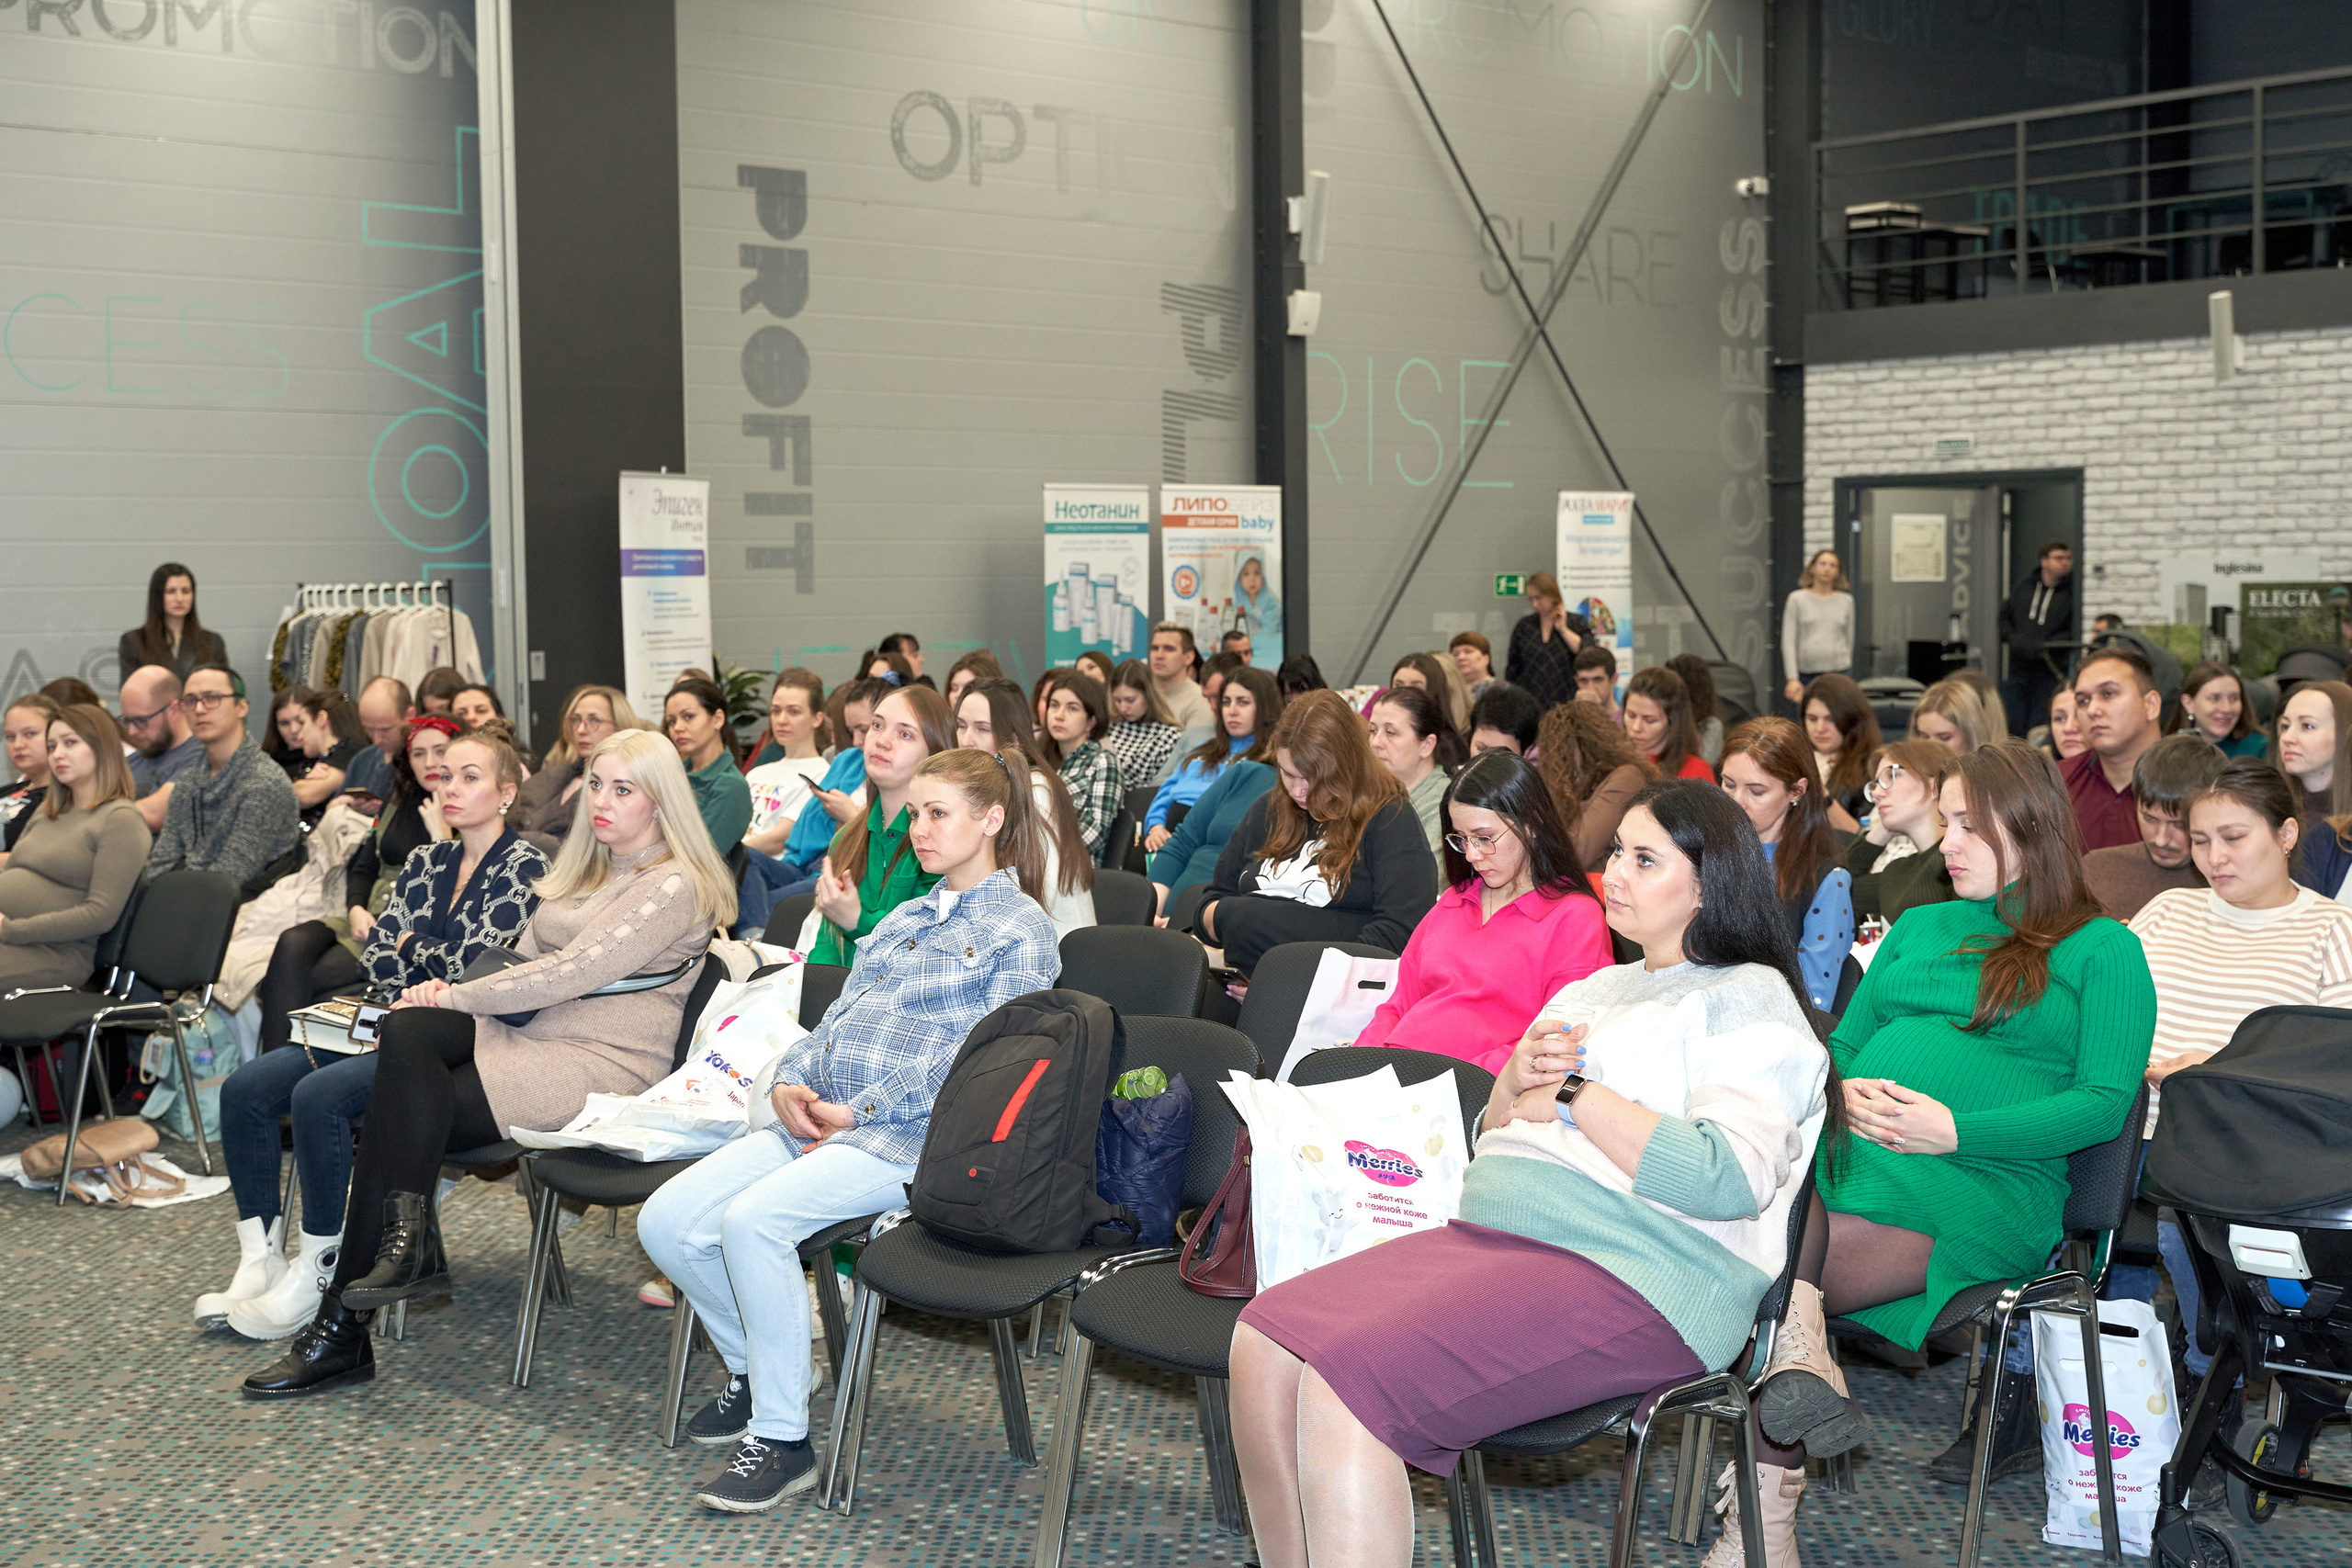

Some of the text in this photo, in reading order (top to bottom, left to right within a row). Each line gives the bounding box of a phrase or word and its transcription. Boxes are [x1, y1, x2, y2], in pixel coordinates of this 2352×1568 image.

[0, 0, 479, 79] ROMOTION
[1477, 212, 1680, 309] SHARE
[737, 164, 814, 595] PROFIT
[1054, 501, 1140, 520] Неотанин
[1240, 514, 1274, 532] baby
[2248, 589, 2322, 607] ELECTA
[705, 1049, 754, 1093] YOKOS
[727, 1090, 745, 1108] Japan
[1347, 1151, 1424, 1179] Merries
[1368, 1192, 1414, 1205] заботится
[1364, 1202, 1402, 1214] нежной
[1403, 1209, 1428, 1220] коже
[1373, 1215, 1414, 1228] малыша
[2063, 1420, 2142, 1448] Meies
[2078, 1468, 2128, 1481] забтся
[2116, 1484, 2142, 1493] коже
[2085, 1493, 2127, 1503] маша
